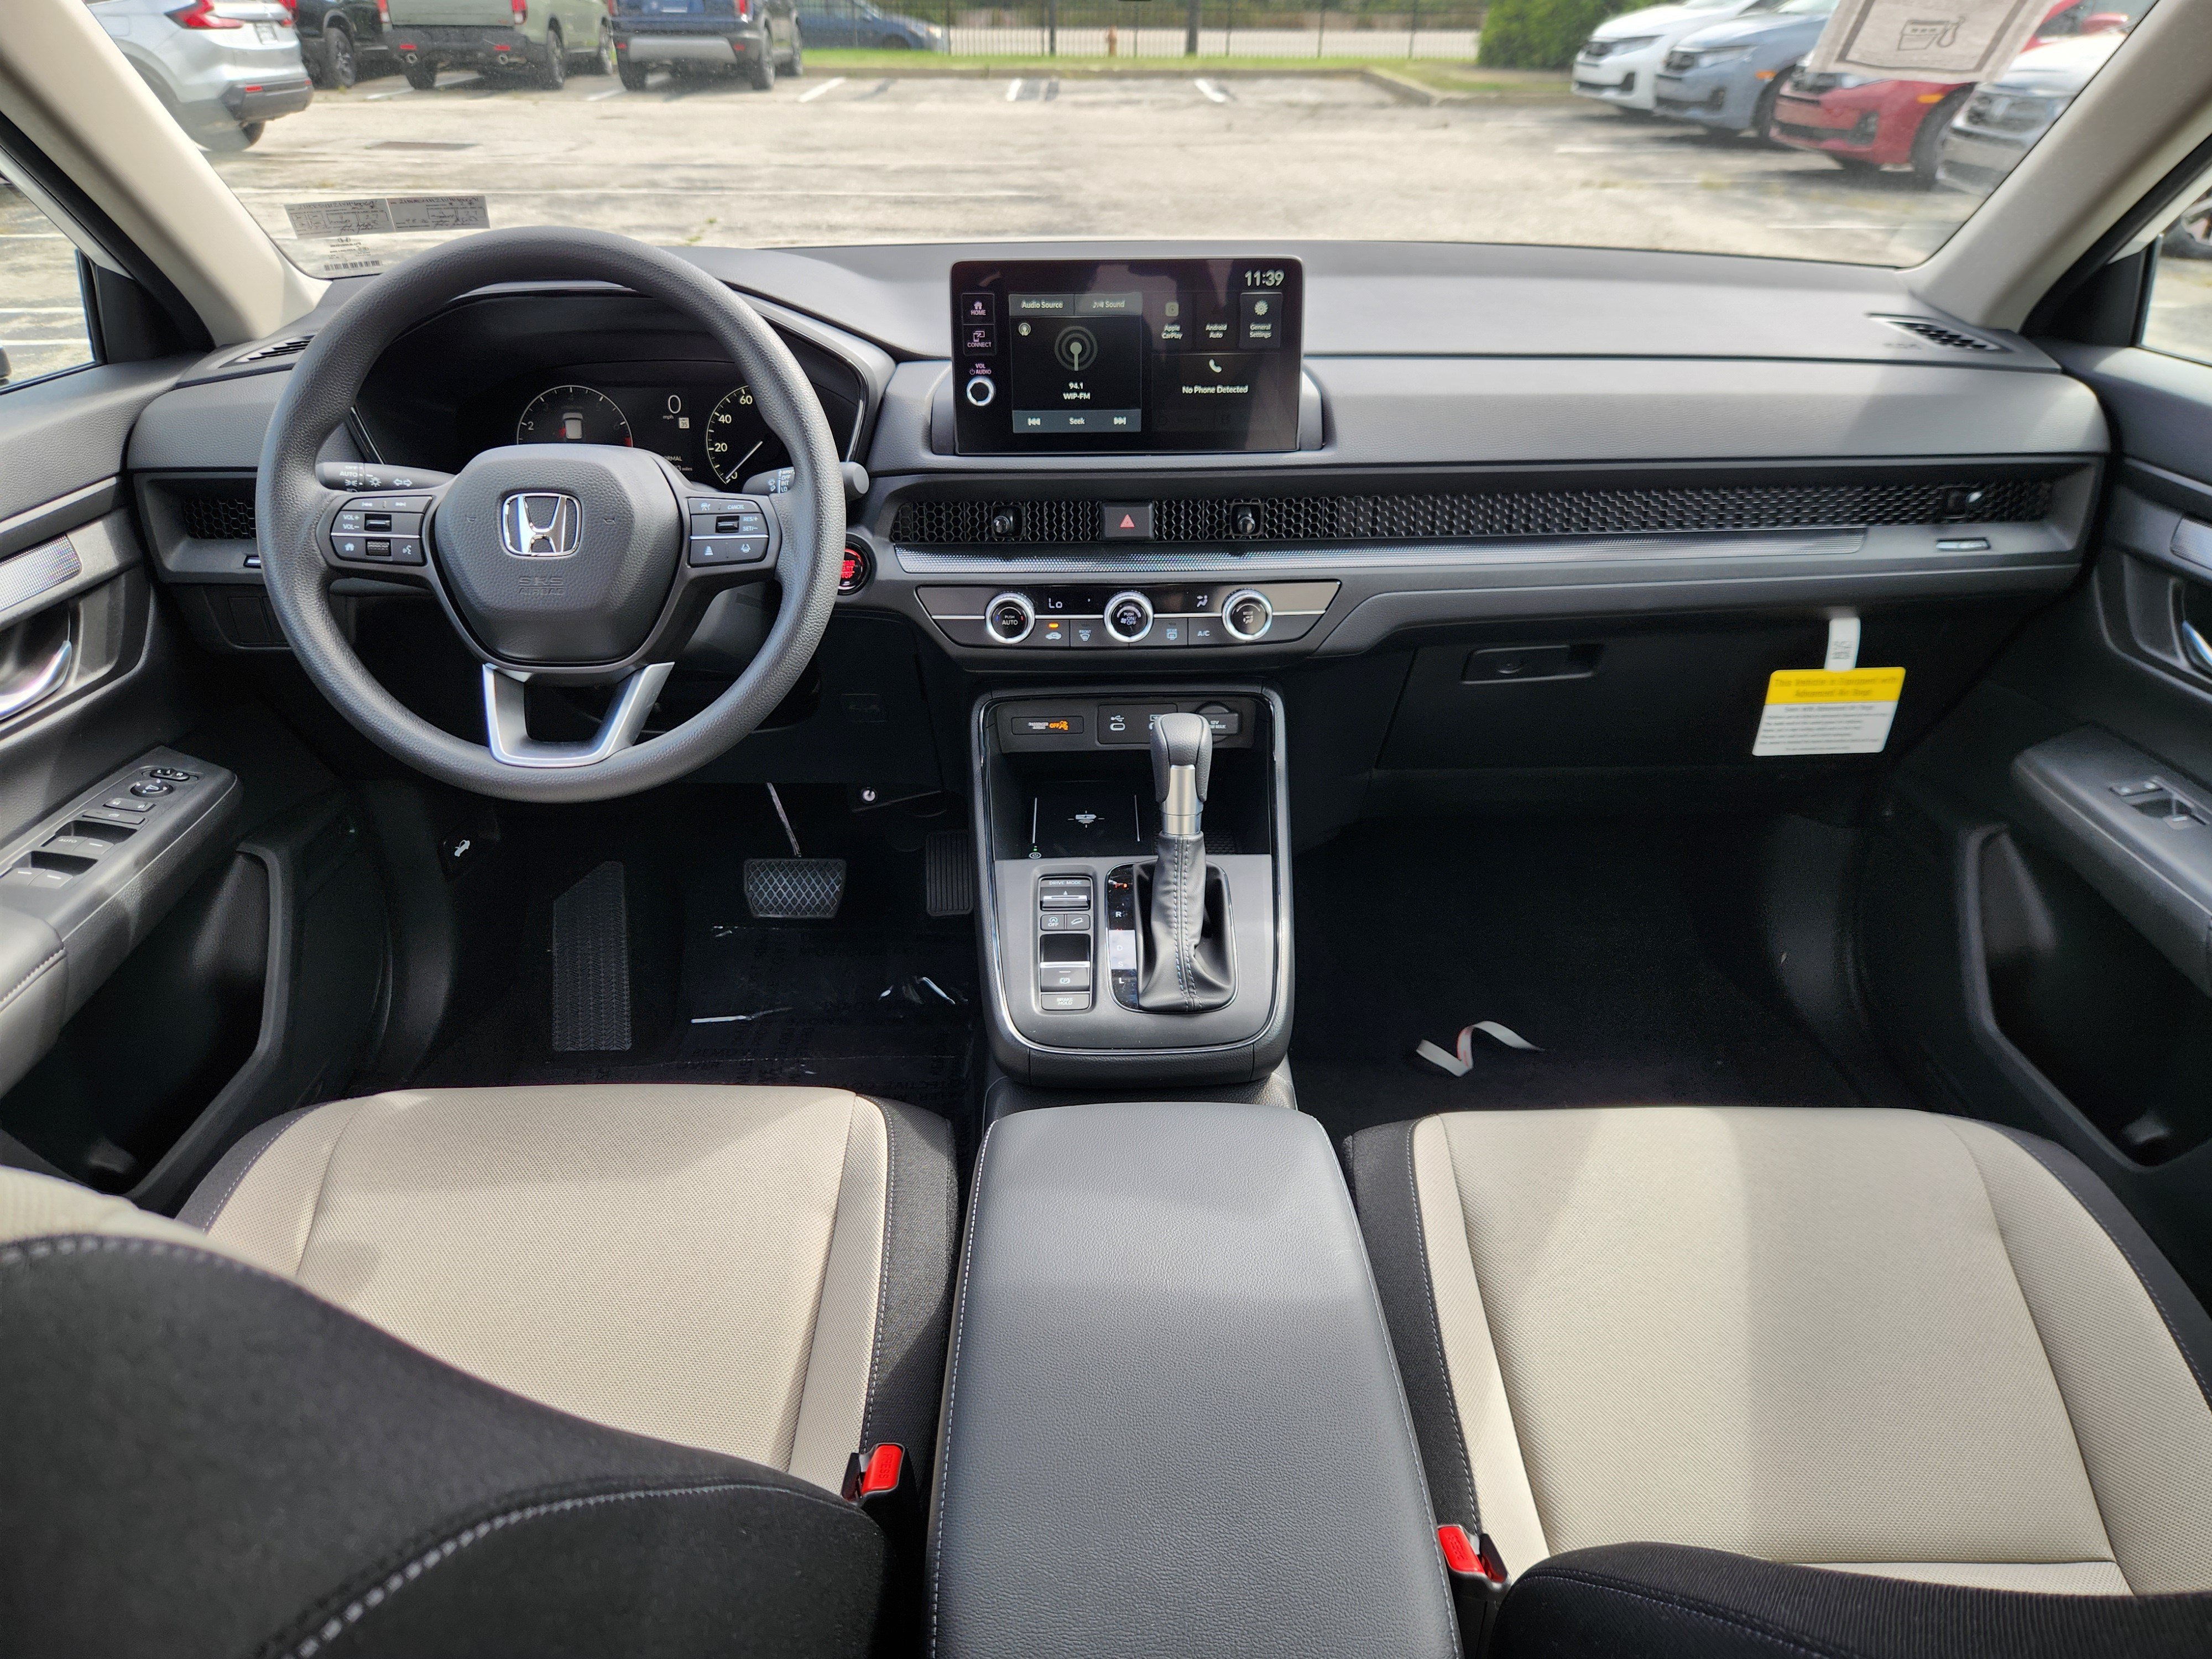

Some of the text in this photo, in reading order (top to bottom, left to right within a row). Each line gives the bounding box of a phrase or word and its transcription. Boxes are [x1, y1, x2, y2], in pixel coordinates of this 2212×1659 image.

[1245, 270, 1285, 286] 11:39
[1021, 300, 1063, 309] Audio Source
[1105, 299, 1126, 308] Sound
[1164, 324, 1181, 332] Apple
[1206, 323, 1228, 331] Android
[1249, 322, 1272, 331] General
[1162, 332, 1183, 340] CarPlay
[1182, 384, 1249, 394] No Phone Detected
[668, 395, 681, 414] 0
[740, 395, 753, 405] 60
[718, 414, 732, 424] 40
[1069, 417, 1086, 425] Seek
[528, 421, 534, 430] 2
[714, 442, 728, 452] 20
[1048, 598, 1063, 608] Lo
[879, 1453, 893, 1479] PRESS
